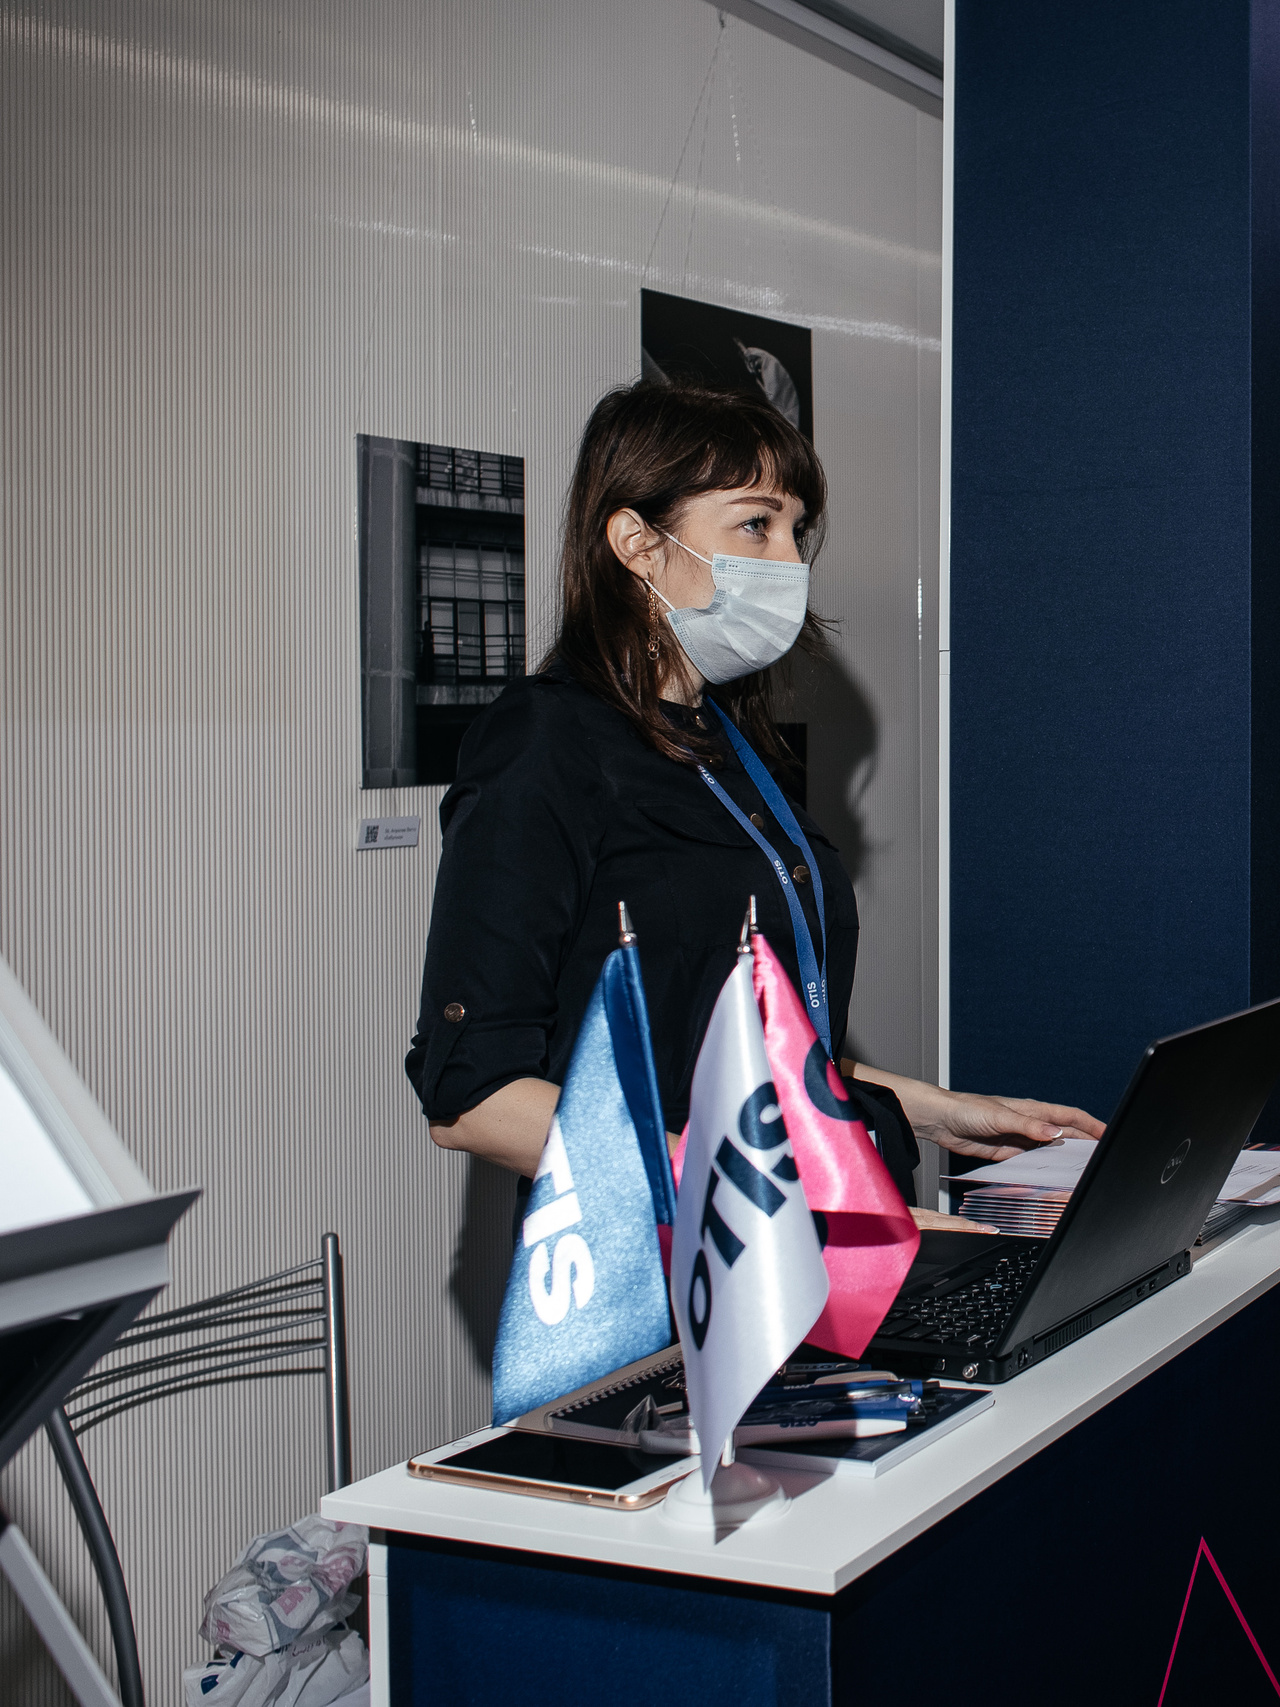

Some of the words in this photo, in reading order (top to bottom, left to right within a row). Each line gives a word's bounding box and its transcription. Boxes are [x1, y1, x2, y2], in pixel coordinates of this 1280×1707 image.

[697, 764, 715, 785] OTIS
[773, 859, 789, 885] OTIS
[807, 981, 820, 1008] OTIS
[688, 1080, 801, 1352] OTIS
